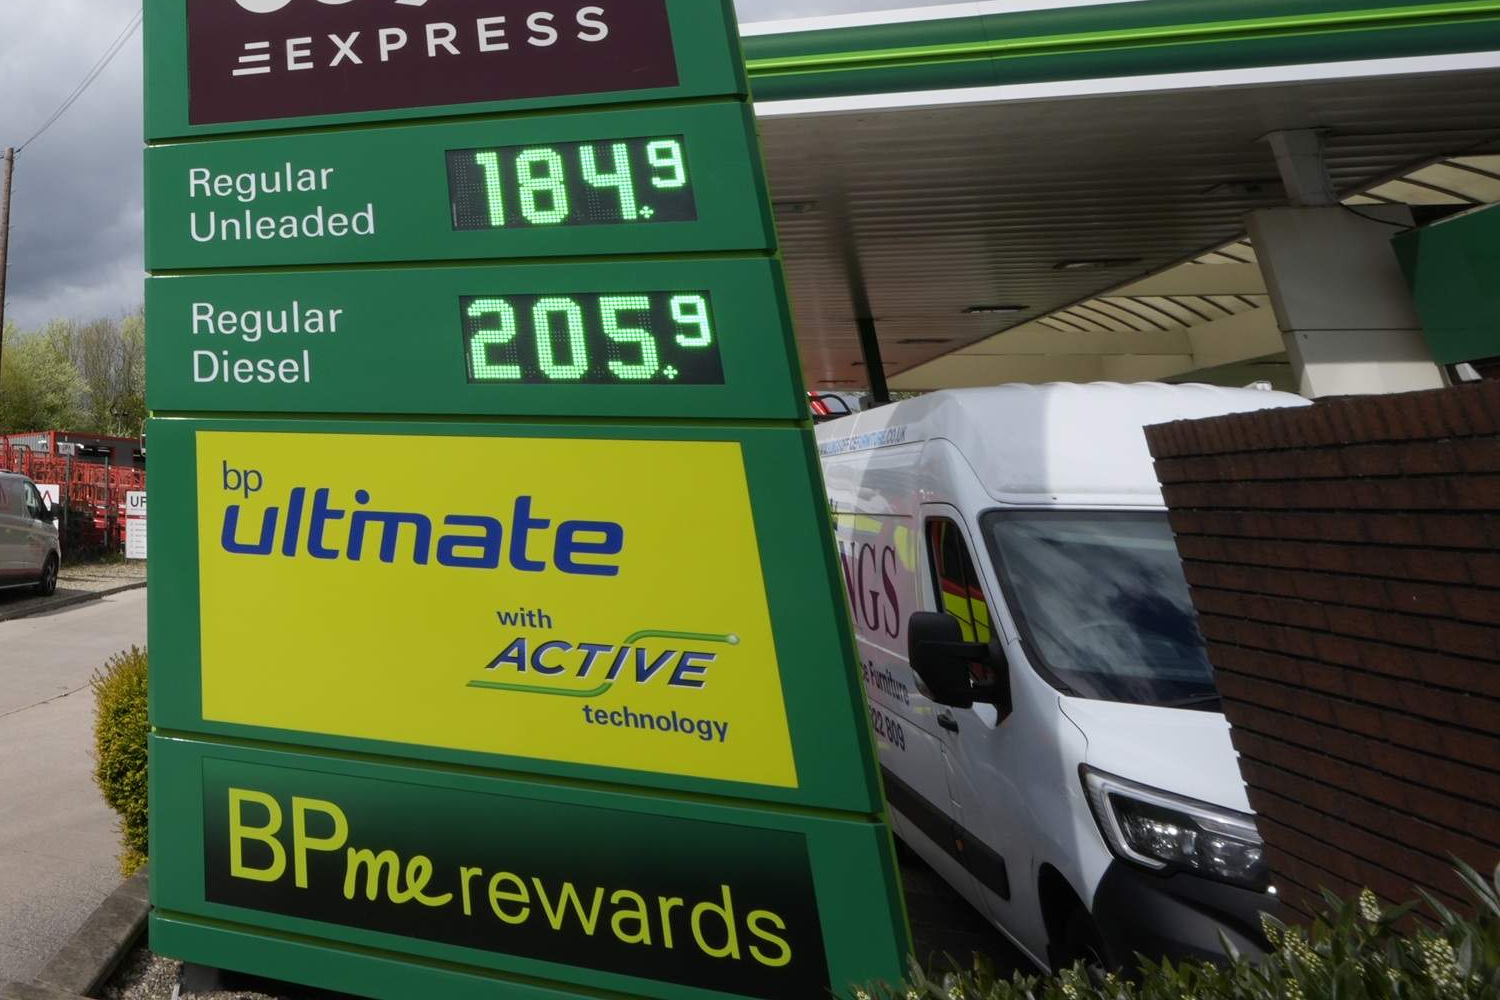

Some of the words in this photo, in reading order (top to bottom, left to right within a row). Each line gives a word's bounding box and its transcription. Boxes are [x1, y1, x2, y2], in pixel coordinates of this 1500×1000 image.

[286, 6, 609, 71] EXPRESS
[188, 161, 335, 204] Regular
[189, 203, 376, 243] Unleaded
[191, 301, 343, 342] Regular
[192, 349, 311, 384] Diesel
[222, 460, 263, 498] bp
[220, 486, 625, 577] ultimate
[496, 608, 552, 630] with
[484, 637, 718, 690] ACTIVE
[582, 704, 729, 743] technology
[460, 865, 793, 968] rewards
